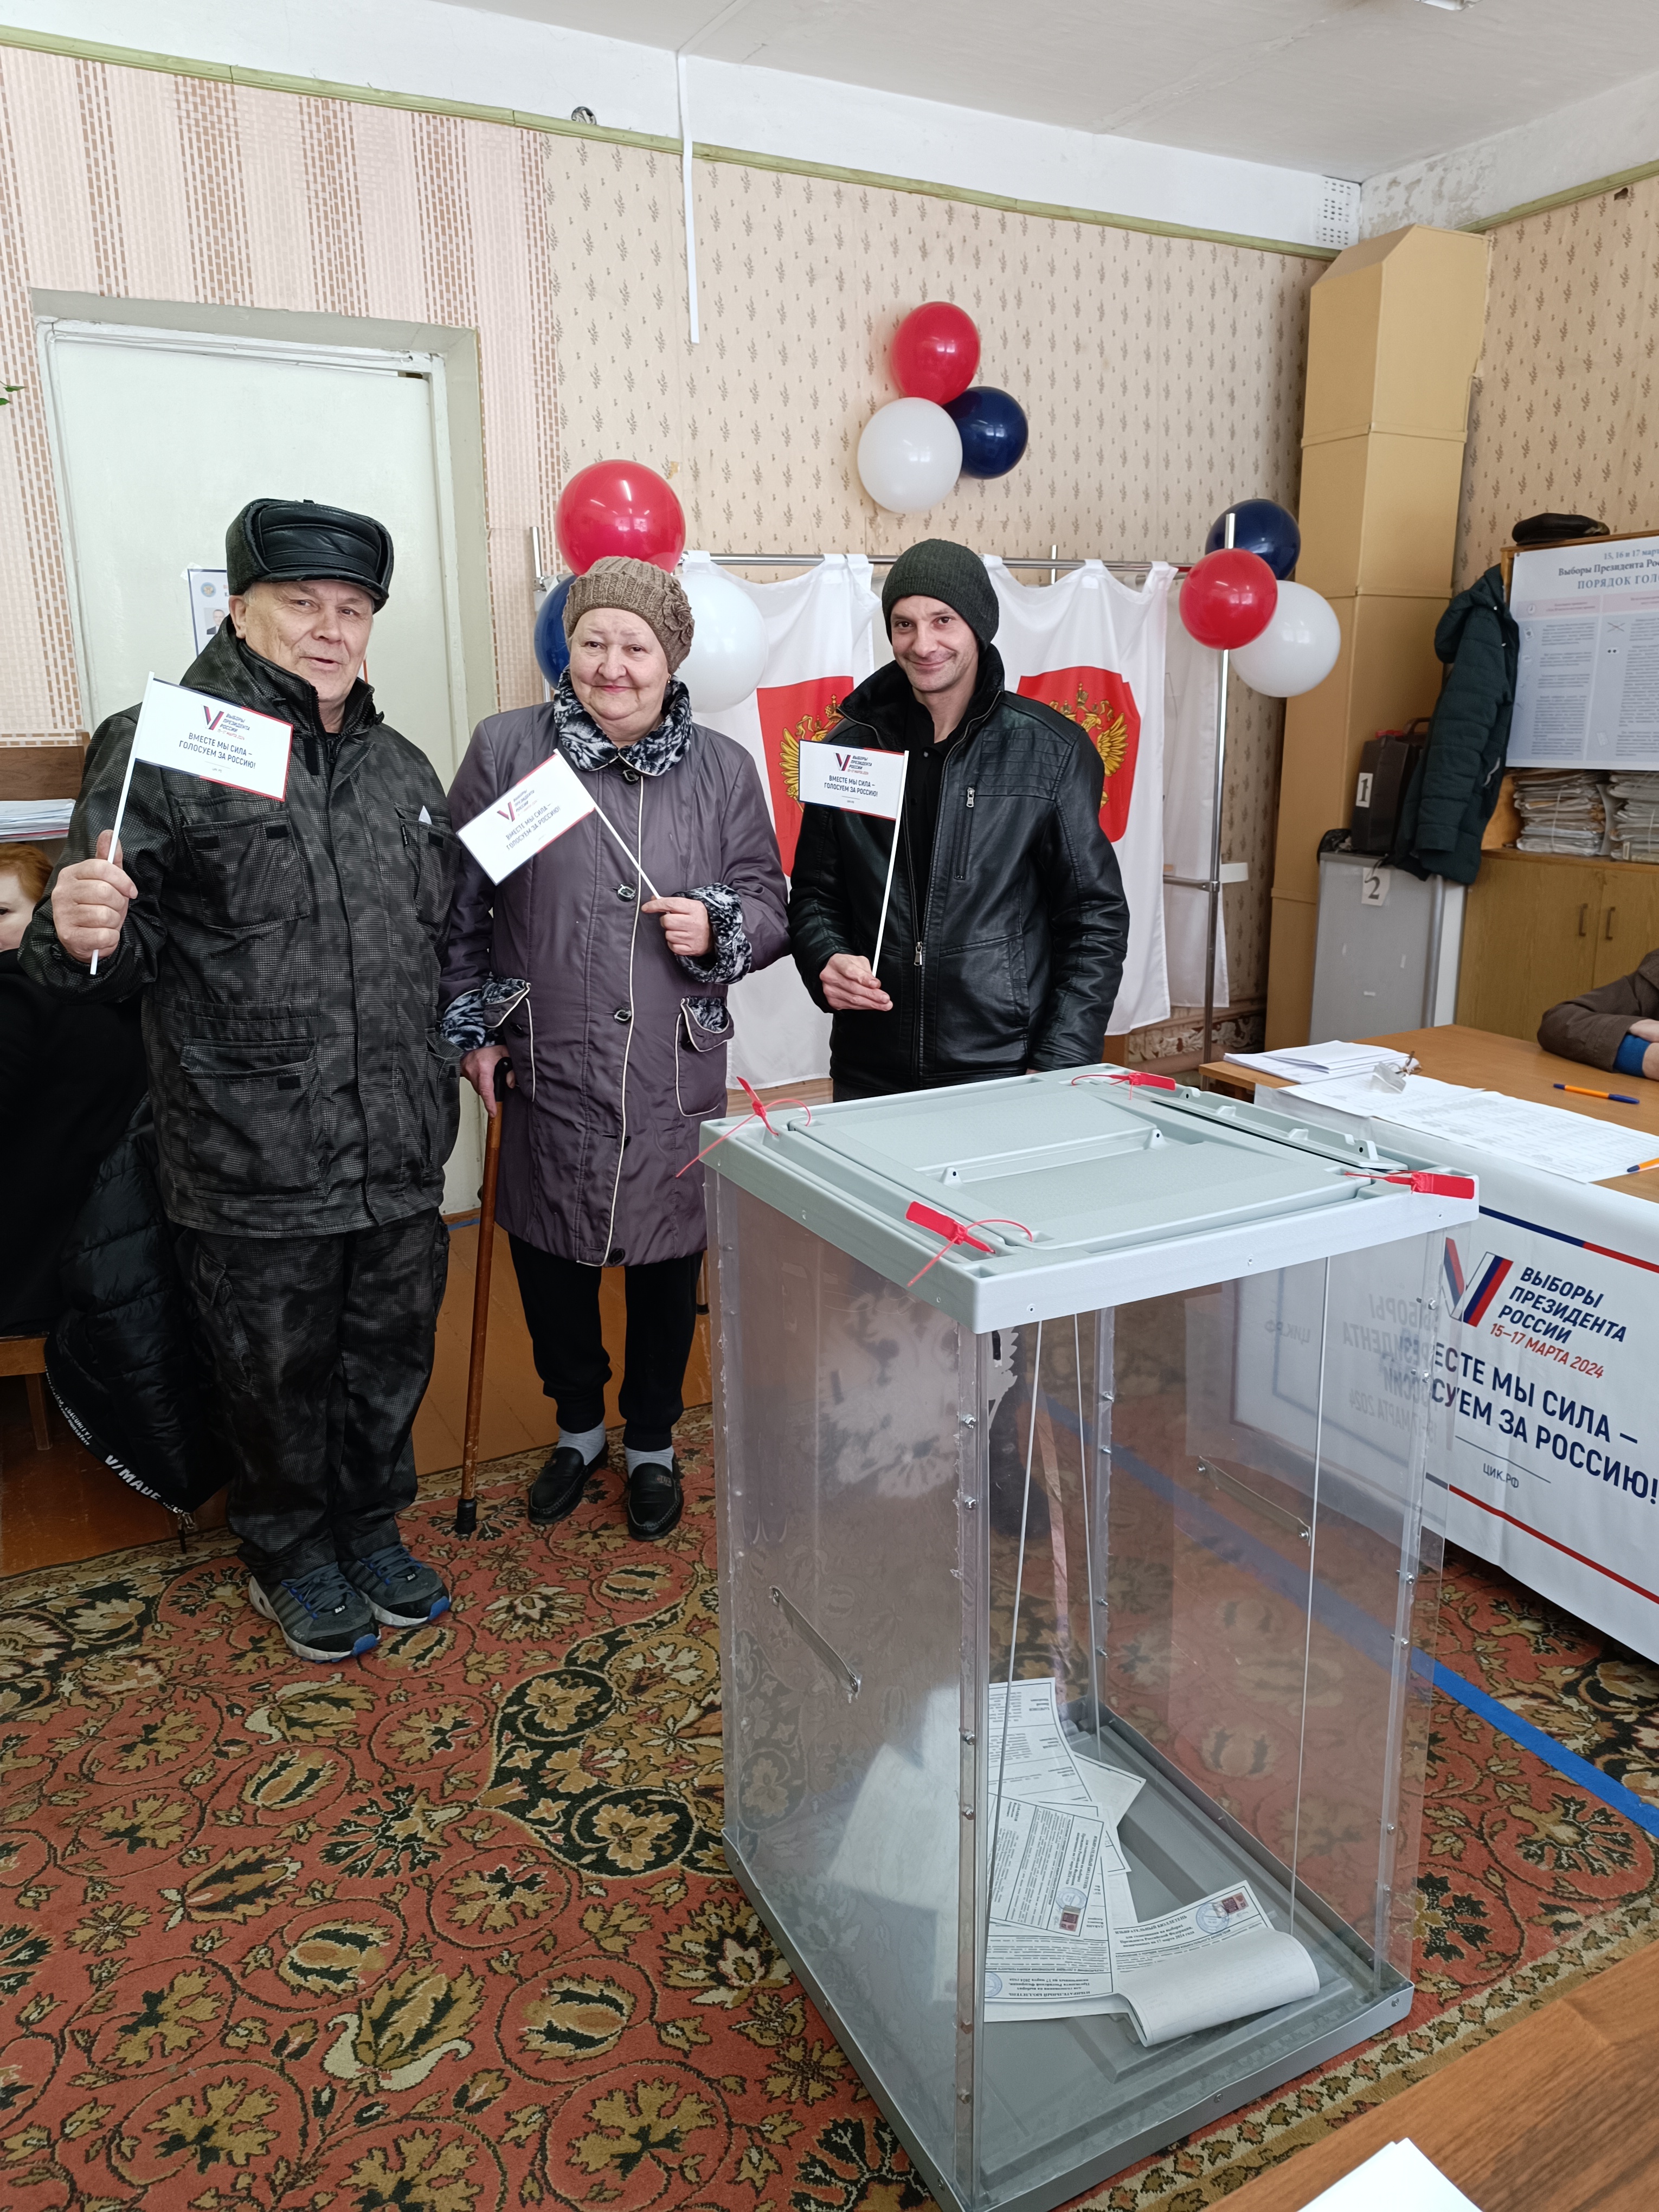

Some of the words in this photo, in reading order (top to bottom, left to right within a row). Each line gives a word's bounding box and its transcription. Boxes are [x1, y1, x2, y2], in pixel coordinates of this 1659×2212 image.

[1558, 567, 1592, 576] Выборы
[1594, 562, 1644, 574] Президента
[1578, 576, 1631, 589] ПОРЯДОК
[1635, 574, 1659, 584] ГОЛ
[179, 741, 216, 757] ГОЛОСУЕМ
[228, 755, 256, 769] РОССИЮ!
[189, 732, 216, 746] ВМЕСТЕ
[217, 741, 229, 750] МЫ
[230, 745, 246, 756] СИЛА
[824, 782, 848, 792] ГОЛОСУЕМ
[857, 788, 878, 797] РОССИЮ!
[829, 775, 847, 783] ВМЕСТЕ
[1359, 778, 1368, 802] 1
[506, 823, 525, 840] ВМЕСТЕ
[525, 815, 535, 825] МЫ
[534, 806, 548, 818] СИЛА
[506, 828, 531, 851] ГОЛОСУЕМ
[1364, 876, 1380, 899] 2
[1520, 1266, 1604, 1308] ВЫБОРЫ
[1498, 1305, 1572, 1343] РОССИИ
[1509, 1285, 1626, 1342] ПРЕЗИДЕНТА
[1525, 1337, 1570, 1365] МАРТА
[1570, 1356, 1604, 1378] 2024
[1435, 1342, 1486, 1385] ЕСТЕ
[1492, 1367, 1535, 1407] МЫ
[1543, 1390, 1610, 1443] СИЛА
[1431, 1378, 1493, 1425] СУЕМ
[1499, 1409, 1528, 1443] ЗА
[1535, 1424, 1658, 1505] РОССИЮ!
[1483, 1463, 1519, 1488] ЦИК.РФ
[1115, 1925, 1157, 1934] ИЗБИРАТЕЛЬНЫЙ
[1157, 1915, 1187, 1928] БЮЛЛЕТЕНЬ
